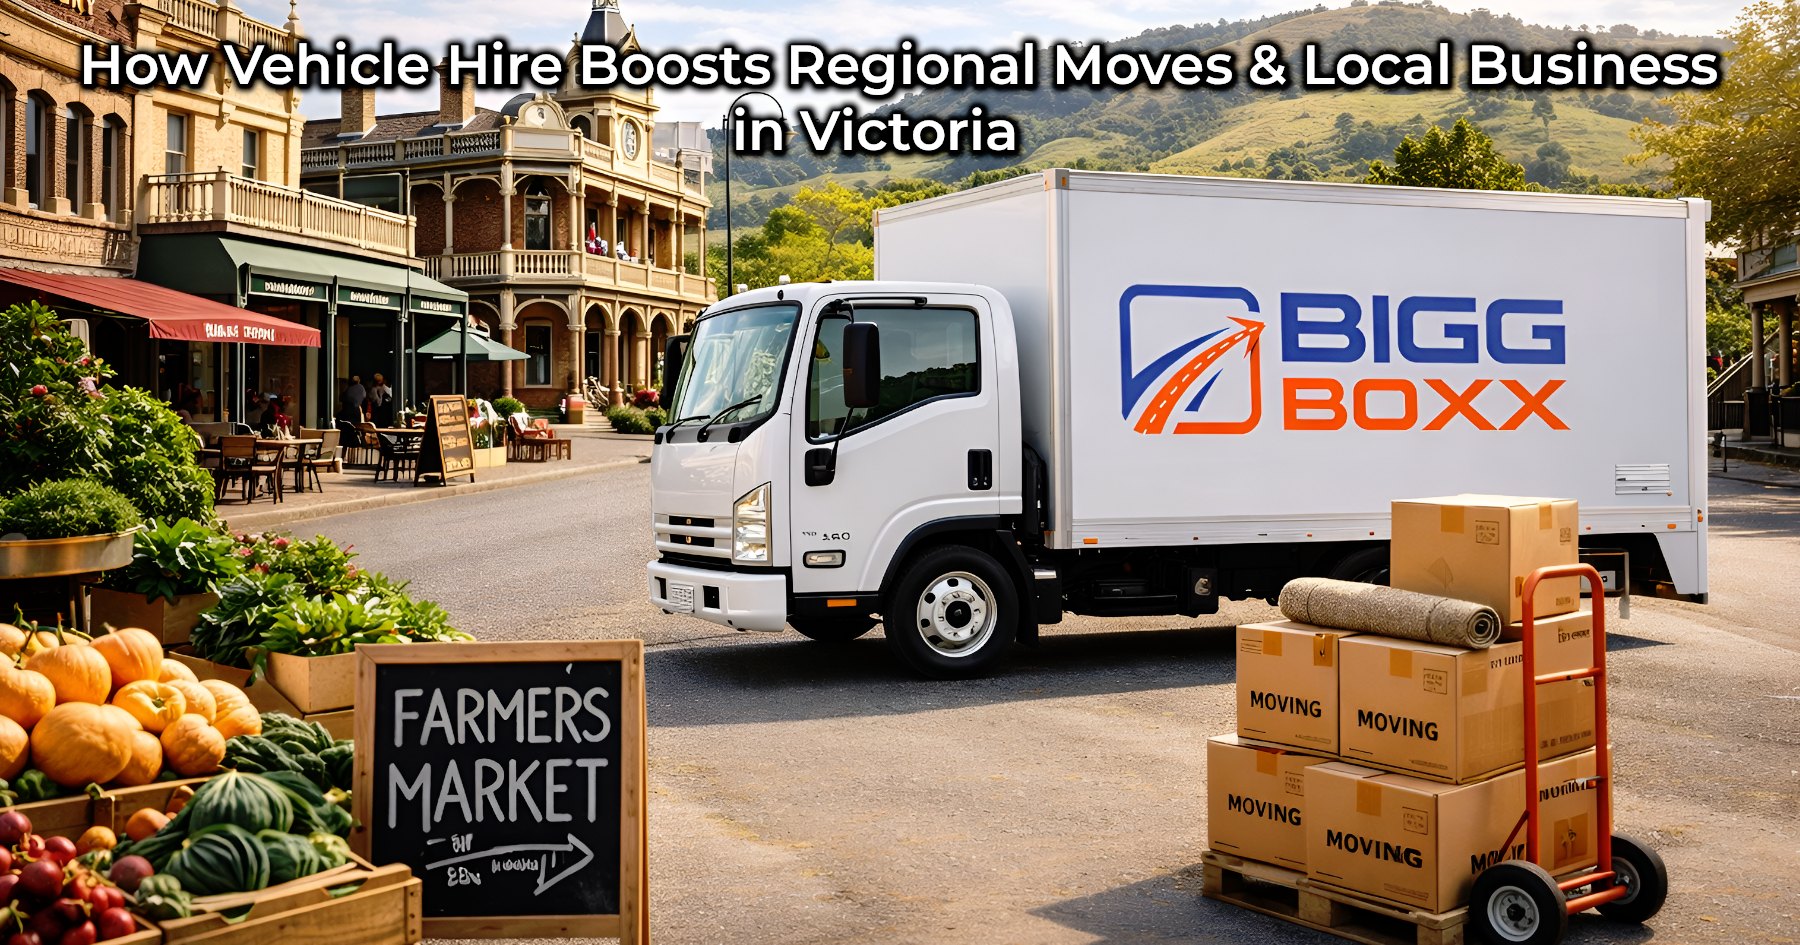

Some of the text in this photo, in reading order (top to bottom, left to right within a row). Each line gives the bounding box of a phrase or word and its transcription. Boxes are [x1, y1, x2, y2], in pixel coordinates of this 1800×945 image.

[1280, 292, 1566, 365] BIGG
[1281, 377, 1571, 432] BOXX
[394, 686, 611, 748] FARMERS
[1250, 690, 1323, 719] MOVING
[1357, 709, 1440, 742] MOVING
[388, 758, 609, 833] MARKET
[1227, 793, 1302, 827] MOVING
[1326, 829, 1423, 869] MOVING
